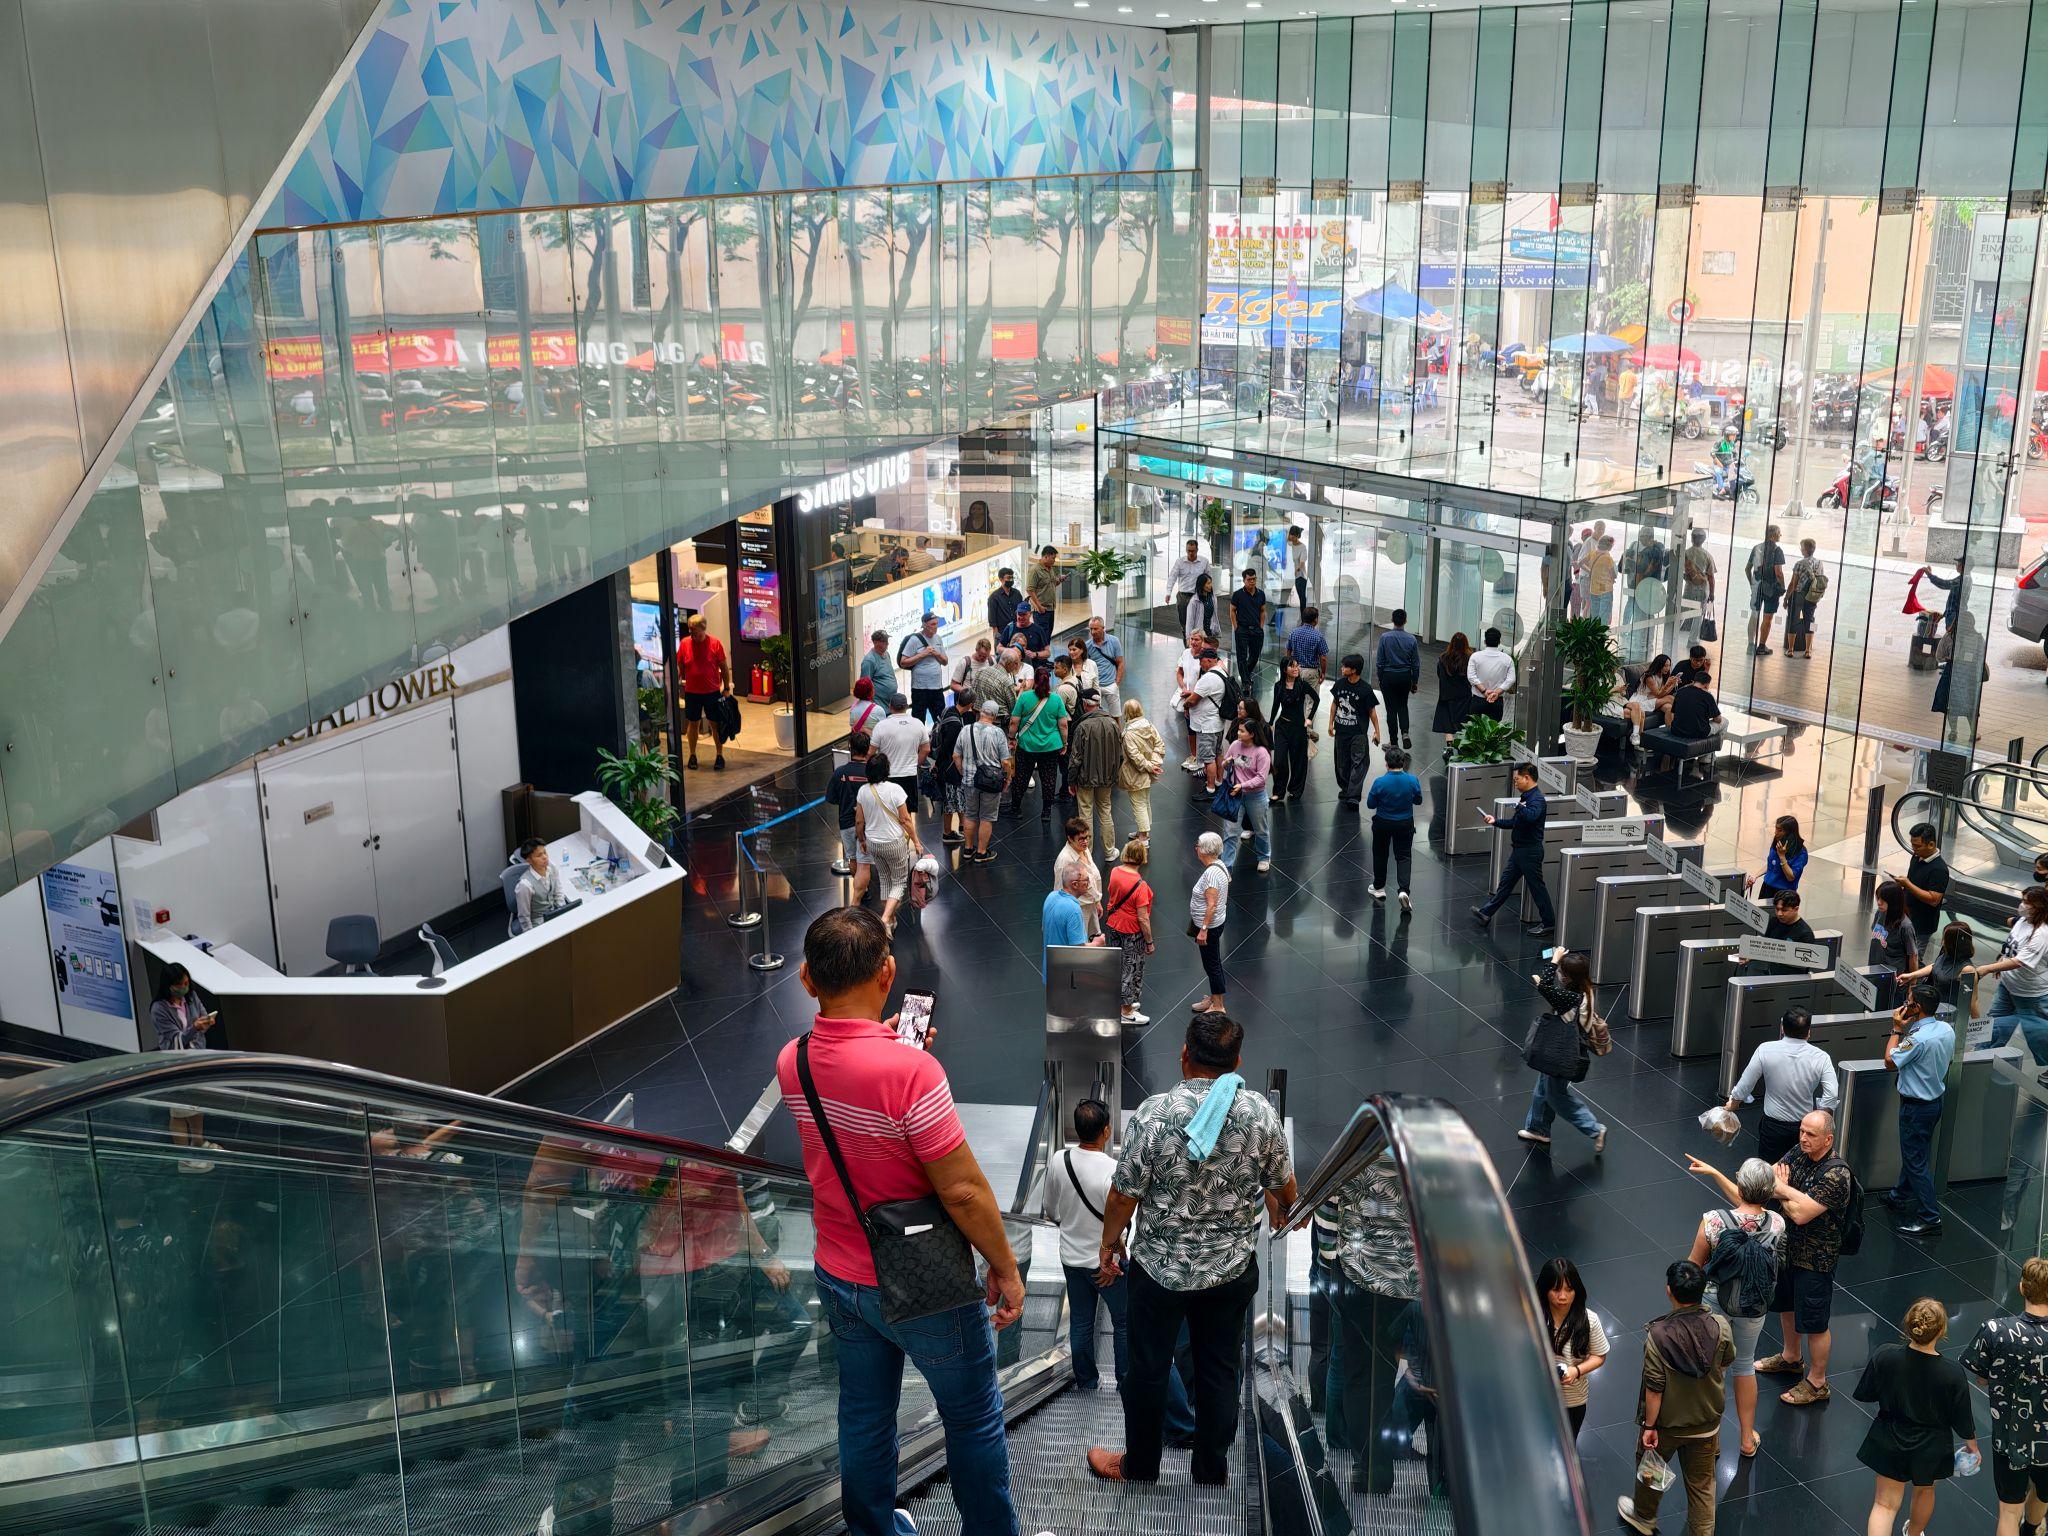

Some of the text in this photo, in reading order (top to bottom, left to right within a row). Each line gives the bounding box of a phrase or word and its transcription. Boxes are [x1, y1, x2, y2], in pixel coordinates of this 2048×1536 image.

[1509, 276, 1535, 285] VĂN
[1207, 289, 1343, 326] Tiger
[797, 451, 911, 514] SAMSUNG
[367, 663, 461, 718] TOWER
